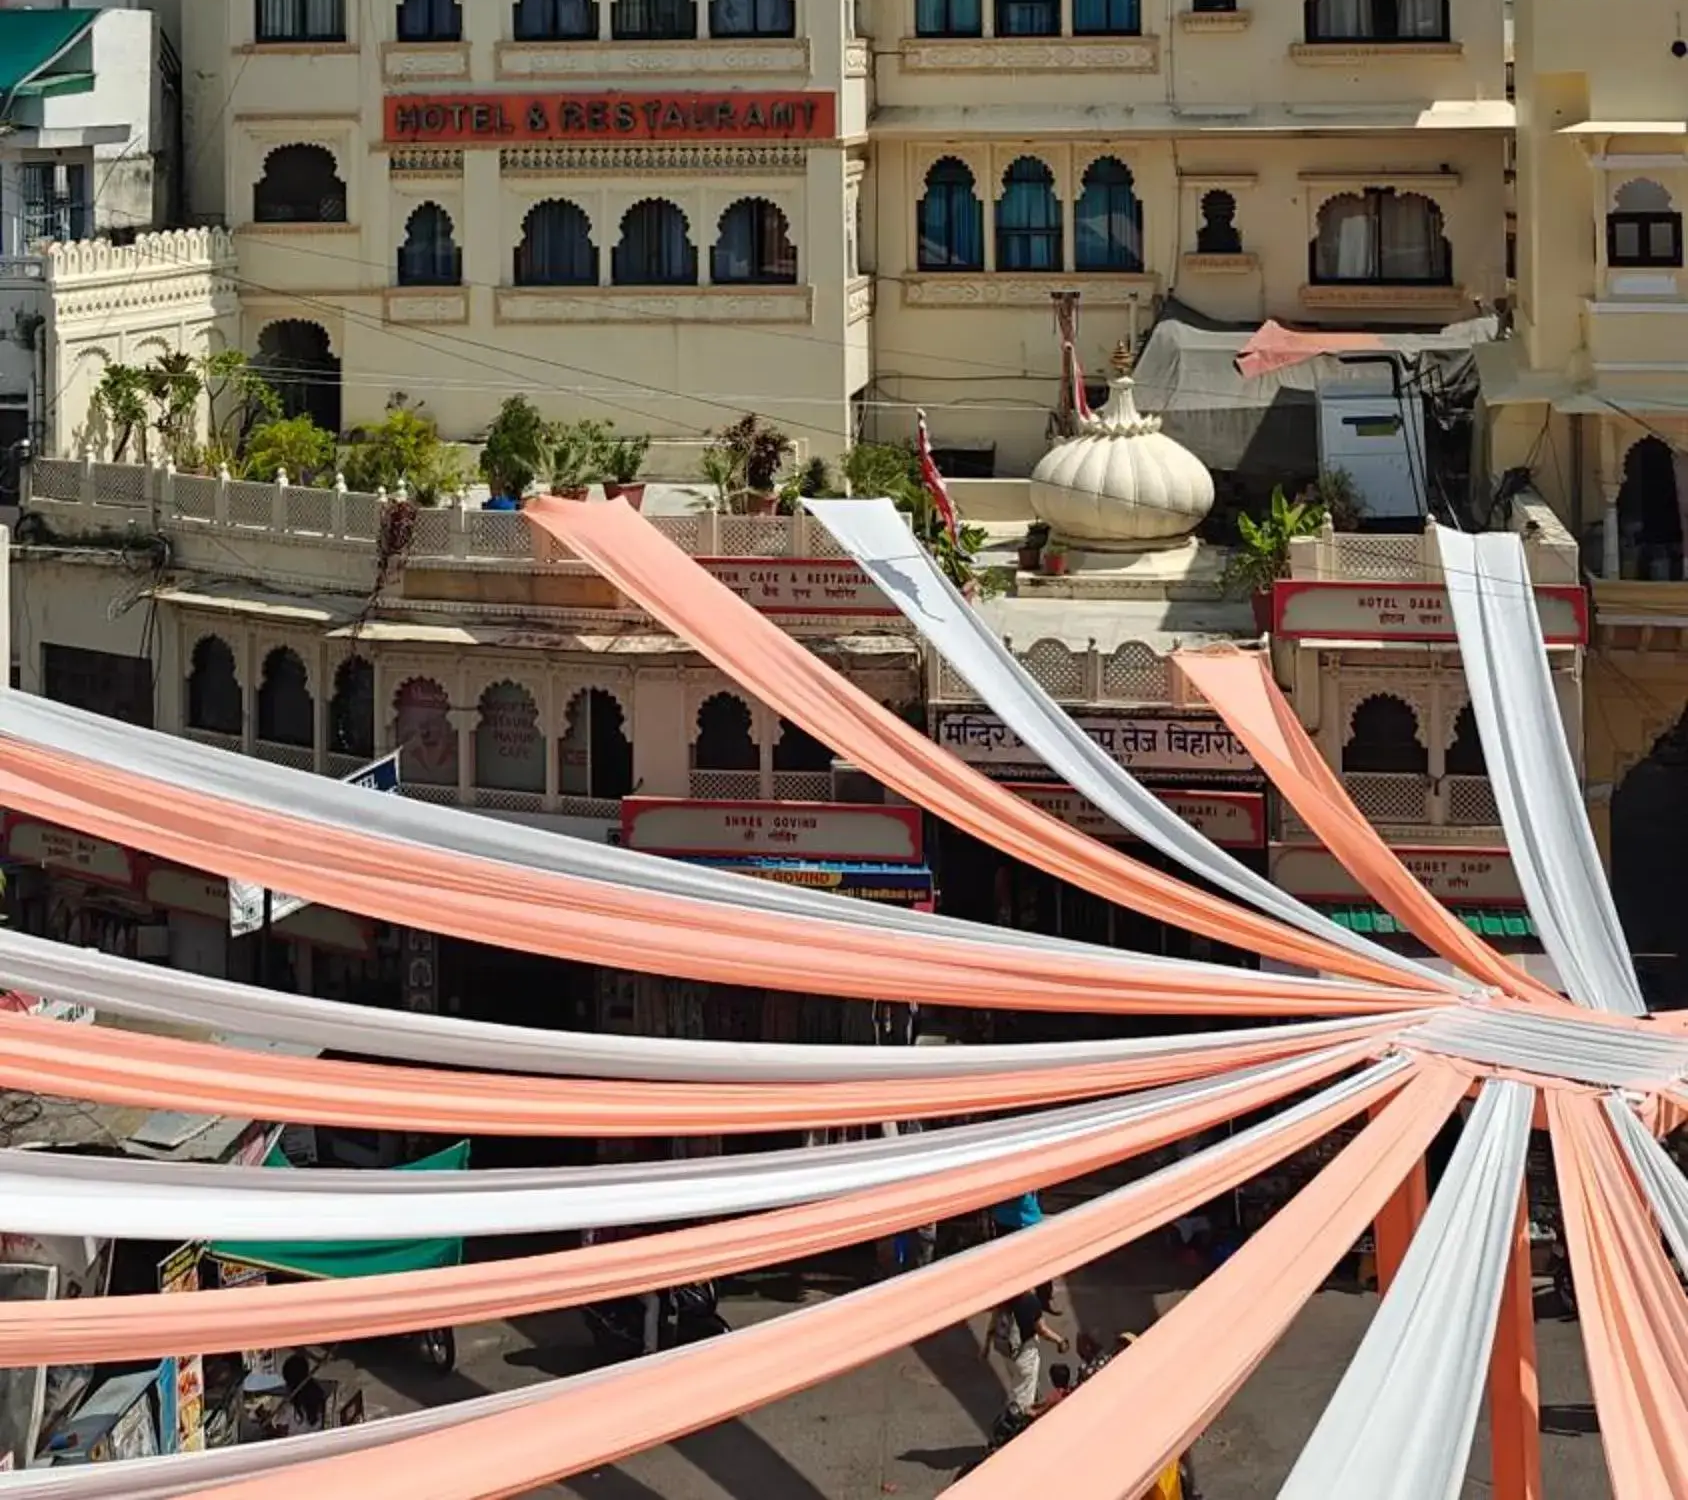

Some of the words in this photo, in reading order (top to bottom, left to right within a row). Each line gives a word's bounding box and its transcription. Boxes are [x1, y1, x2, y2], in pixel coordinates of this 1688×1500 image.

[395, 102, 514, 135] HOTEL
[526, 105, 549, 133] &
[559, 100, 819, 134] RESTAURANT
[750, 571, 779, 583] CAFE
[1358, 597, 1398, 609] HOTEL
[1121, 721, 1158, 752] तेज
[1407, 861, 1447, 873] AGNET
